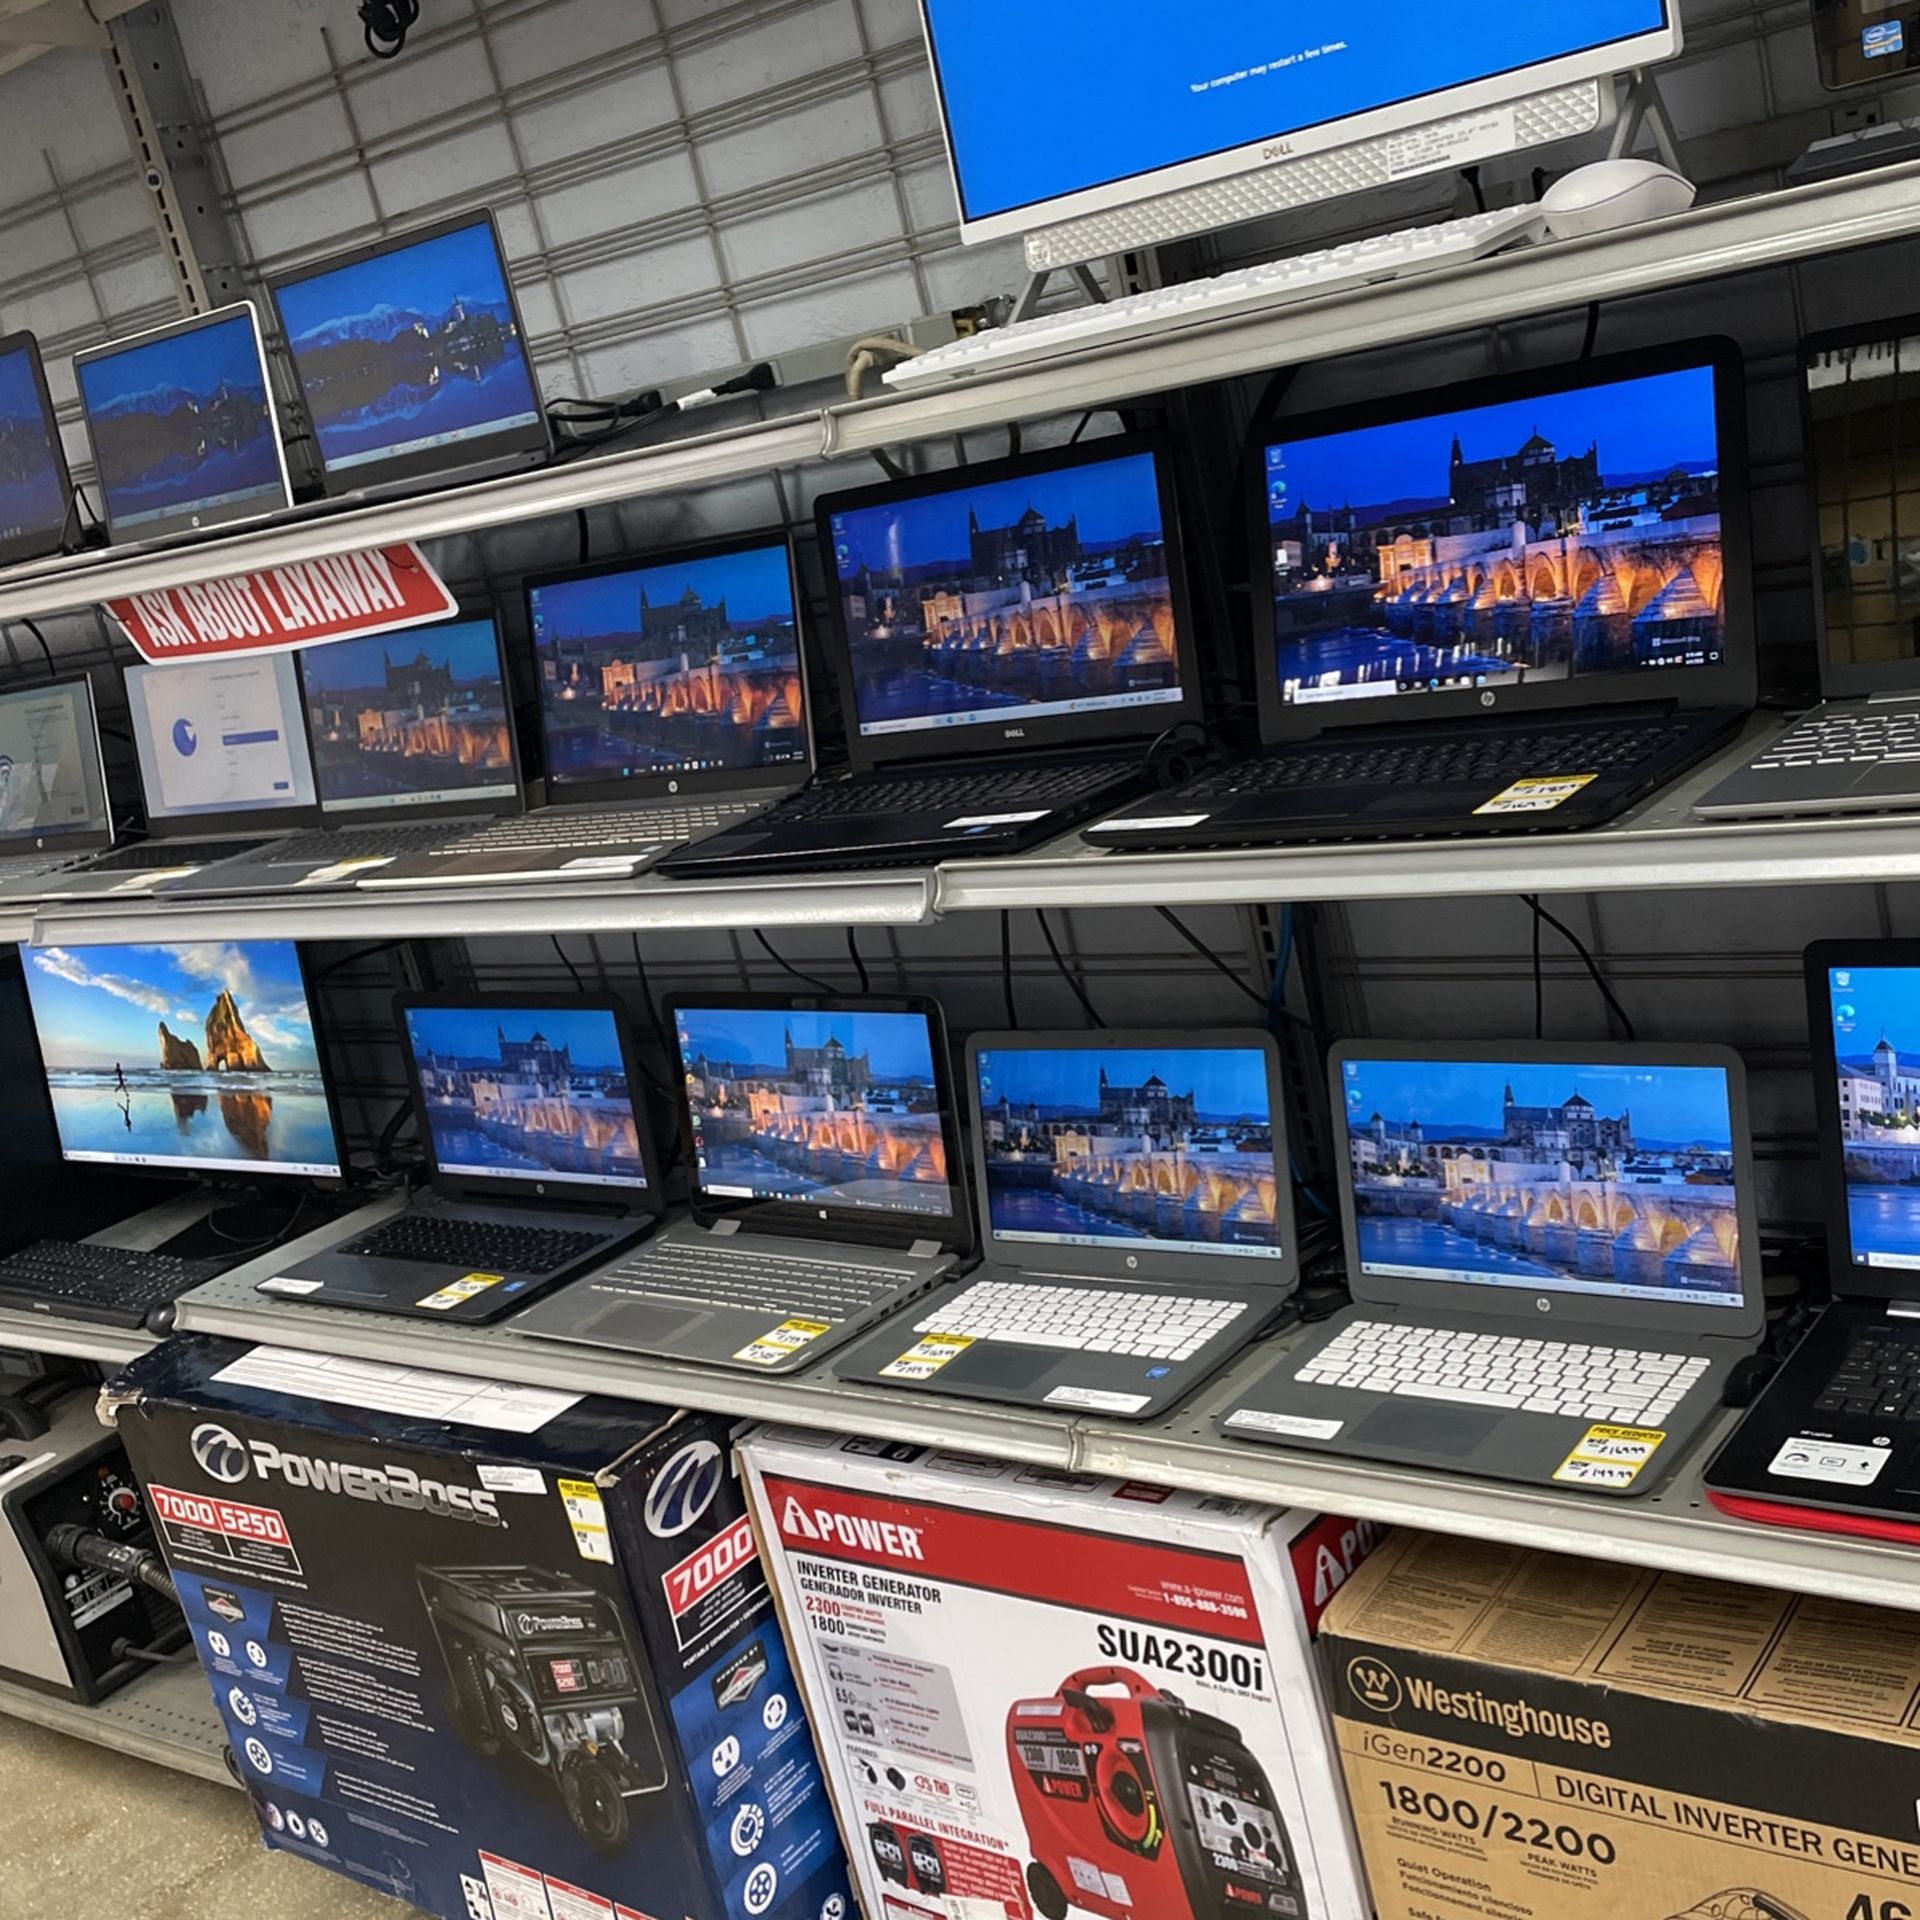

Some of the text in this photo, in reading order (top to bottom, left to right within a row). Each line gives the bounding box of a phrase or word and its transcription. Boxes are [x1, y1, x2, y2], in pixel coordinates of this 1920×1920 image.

[1190, 82, 1209, 93] Your
[1210, 70, 1248, 88] computer
[1249, 65, 1267, 76] may
[1268, 55, 1297, 70] restart
[1304, 49, 1320, 60] few
[1263, 142, 1293, 160] DELL
[130, 549, 406, 648] ASK ABOUT LAYAWAY
[1004, 728, 1026, 739] DELL
[156, 1492, 216, 1525] 7000
[221, 1506, 284, 1540] 5250
[672, 1523, 754, 1606] 7000
[797, 1560, 941, 1603] INVERTER GENERATOR
[801, 1578, 922, 1614] GENERADOR INVERTER
[805, 1596, 841, 1617] 2300
[812, 1615, 845, 1635] 1800
[1097, 1624, 1263, 1691] SUA2300i
[1404, 1676, 1612, 1749] Westinghouse
[1363, 1731, 1507, 1782] iGen2200
[934, 1779, 950, 1796] THD
[864, 1800, 888, 1816] FULL
[889, 1808, 936, 1835] PARALLEL
[1379, 1781, 1617, 1865] 1800/2200
[1391, 1816, 1477, 1846] RUNNING WATTS
[1554, 1774, 1920, 1878] DIGITAL INVERTER GENE
[1397, 1857, 1492, 1893] Quiet Operation
[1558, 1859, 1598, 1878] WATTS
[1400, 1870, 1534, 1917] Funcionamiento silencioso
